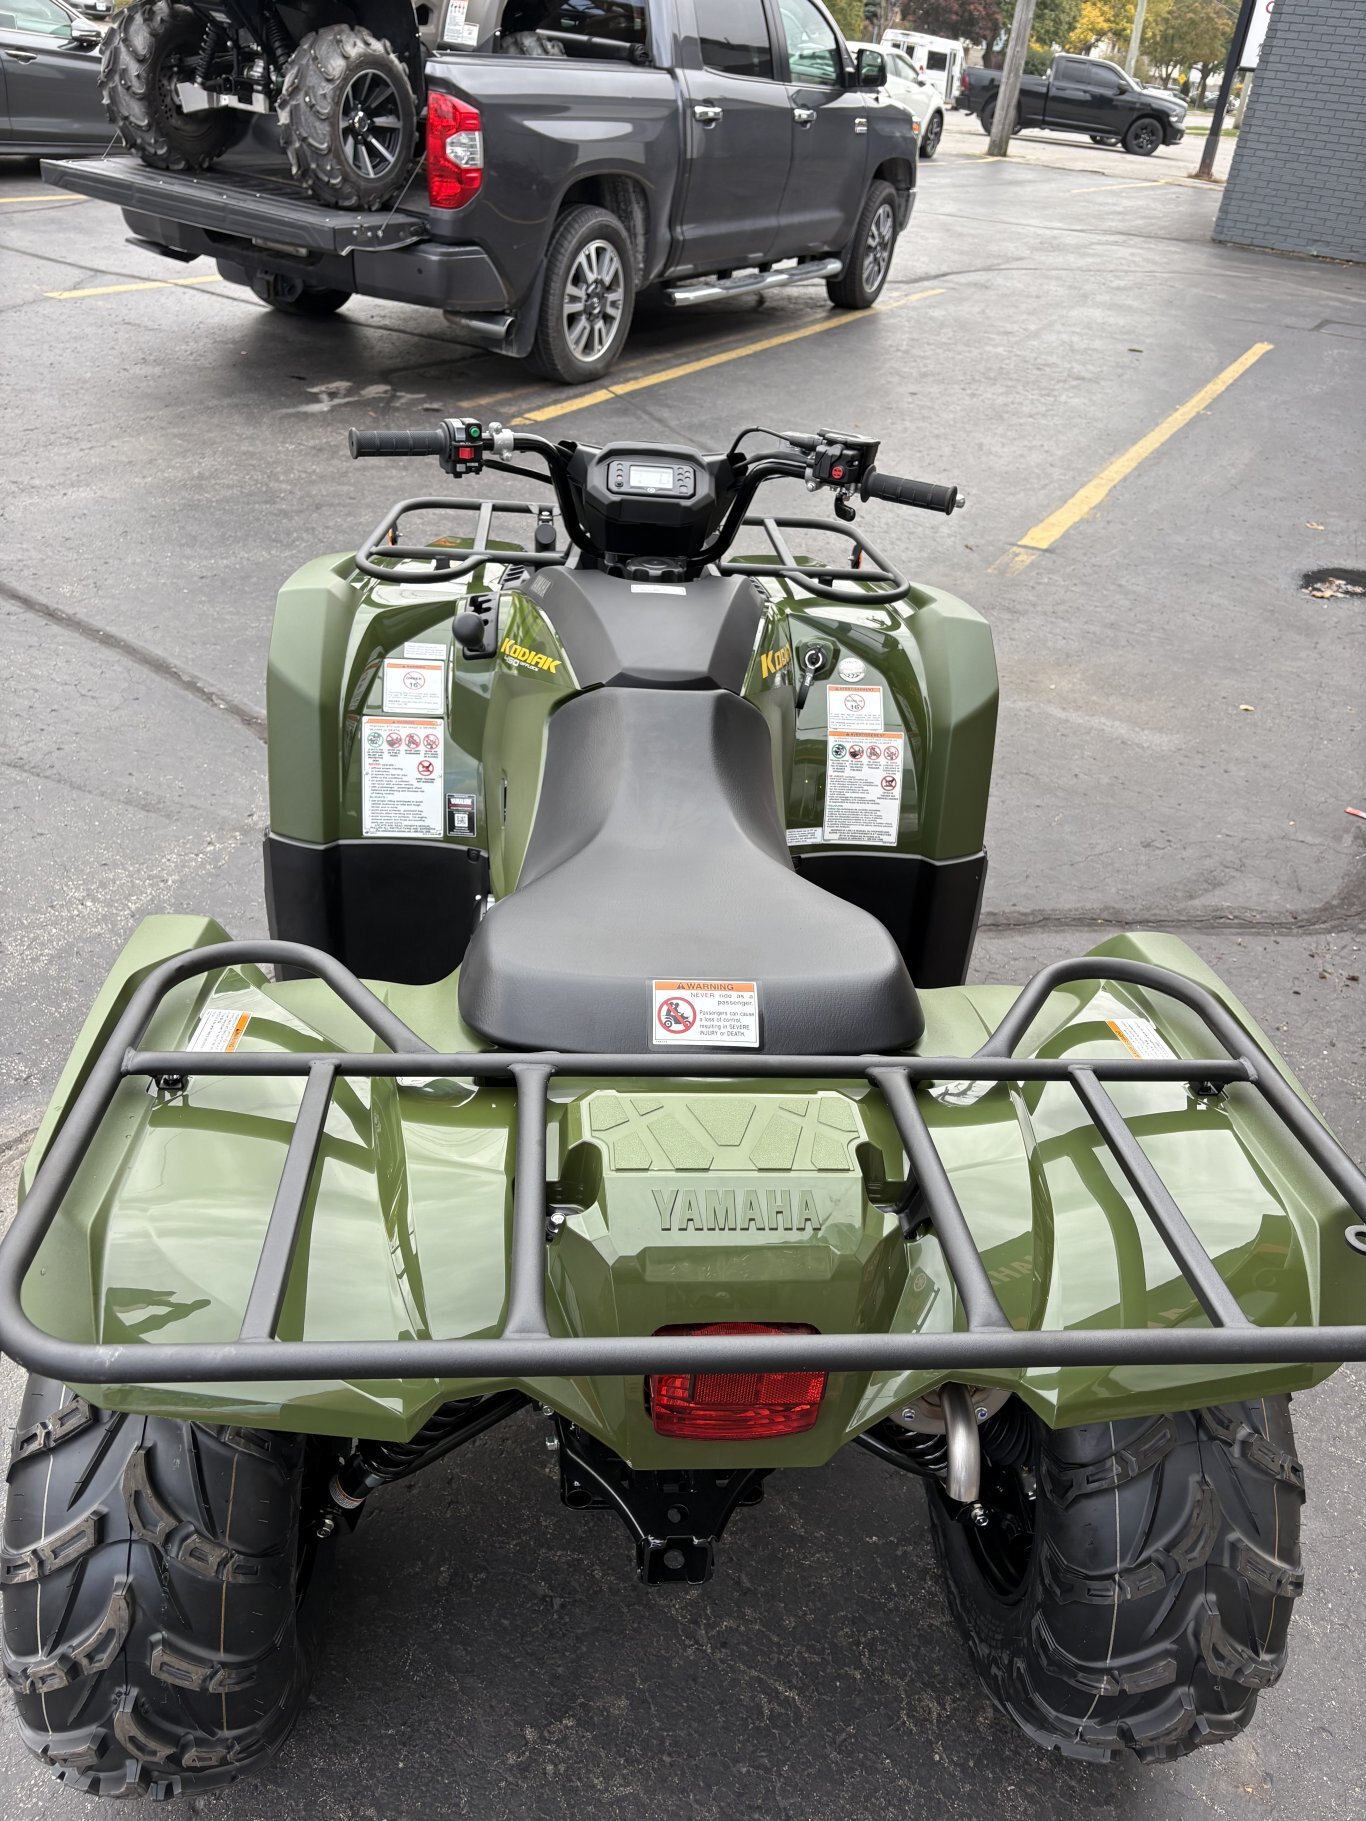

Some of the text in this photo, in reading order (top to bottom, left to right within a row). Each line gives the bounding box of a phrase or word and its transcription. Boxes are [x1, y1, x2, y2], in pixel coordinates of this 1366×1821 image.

[500, 638, 562, 674] KODIAK
[686, 983, 734, 991] WARNING
[699, 1009, 728, 1018] Passengers
[699, 1023, 722, 1031] resulting
[651, 1188, 822, 1231] YAMAHA
